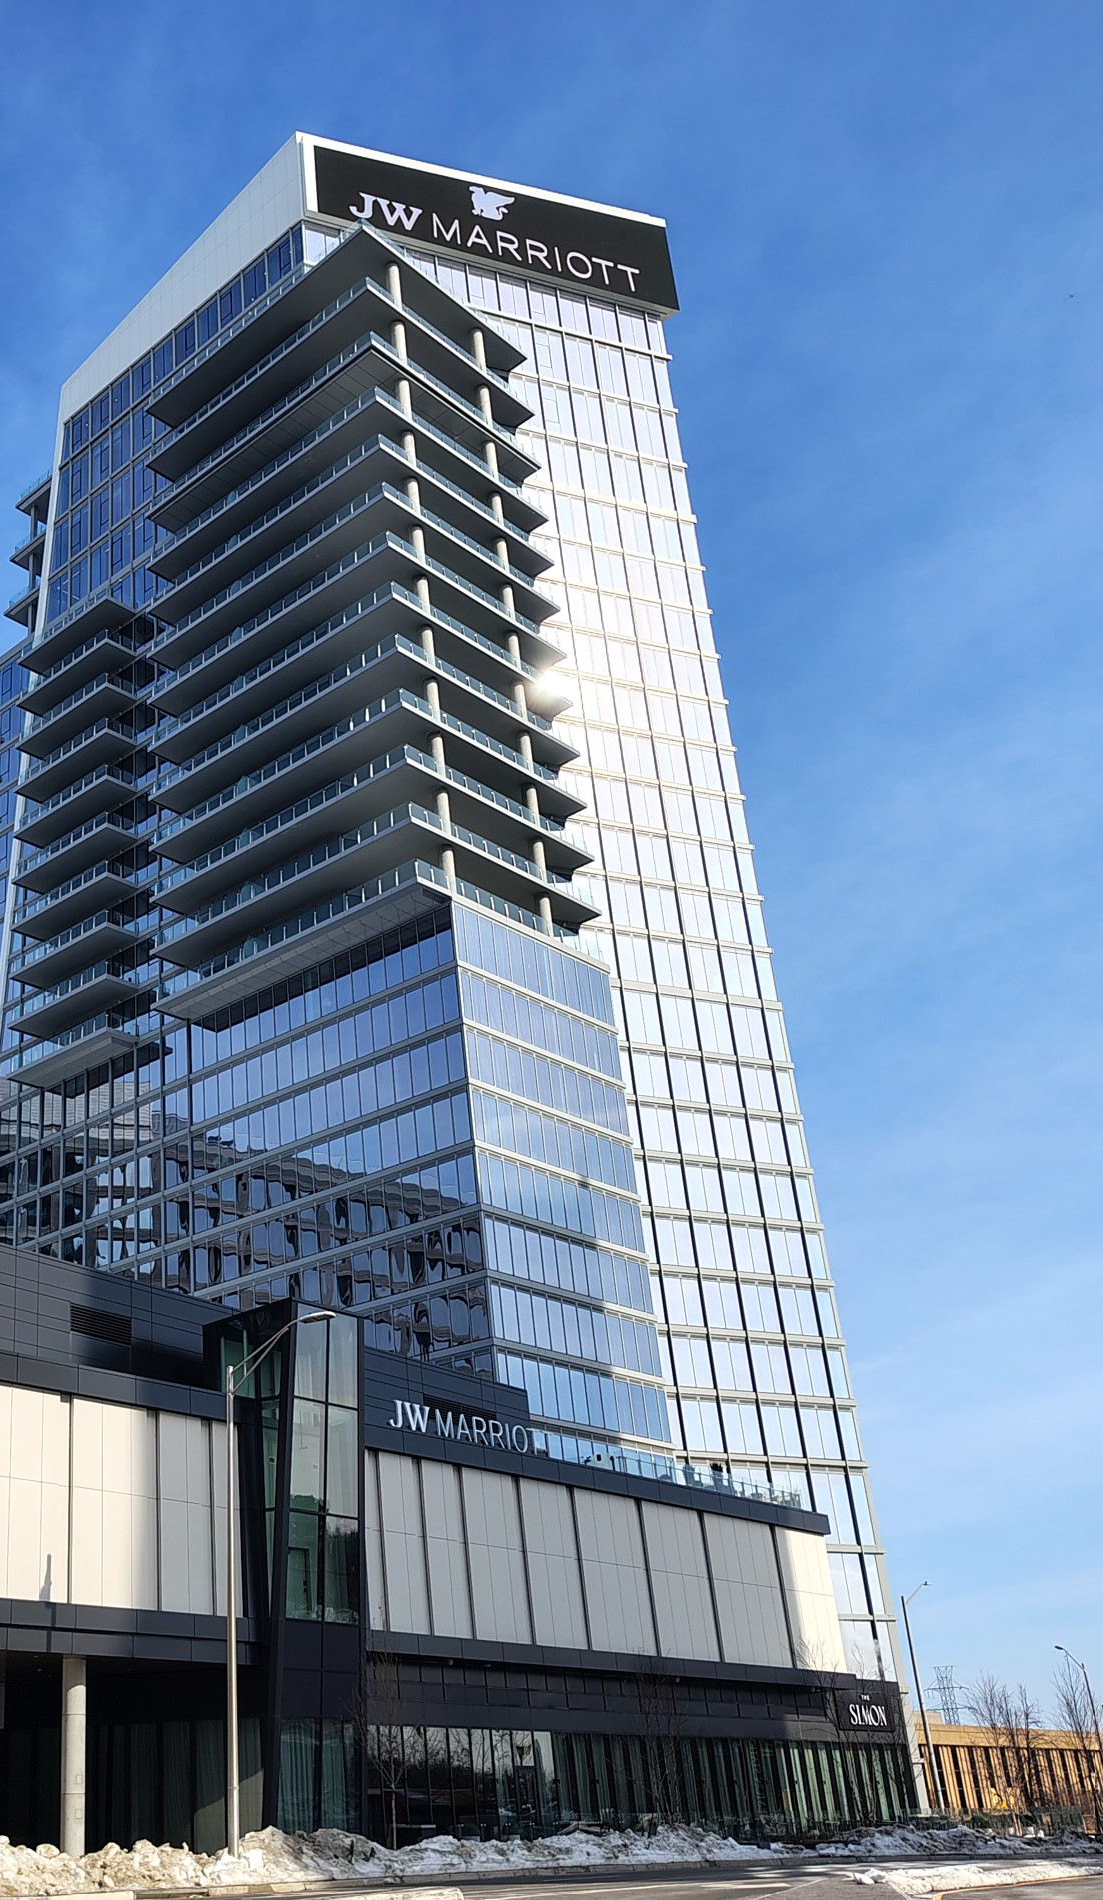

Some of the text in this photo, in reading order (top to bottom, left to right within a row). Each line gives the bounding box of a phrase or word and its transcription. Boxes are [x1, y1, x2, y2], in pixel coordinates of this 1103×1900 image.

[349, 192, 641, 292] JW MARRIOTT
[389, 1399, 431, 1433] JW
[849, 1703, 887, 1726] SIMON
